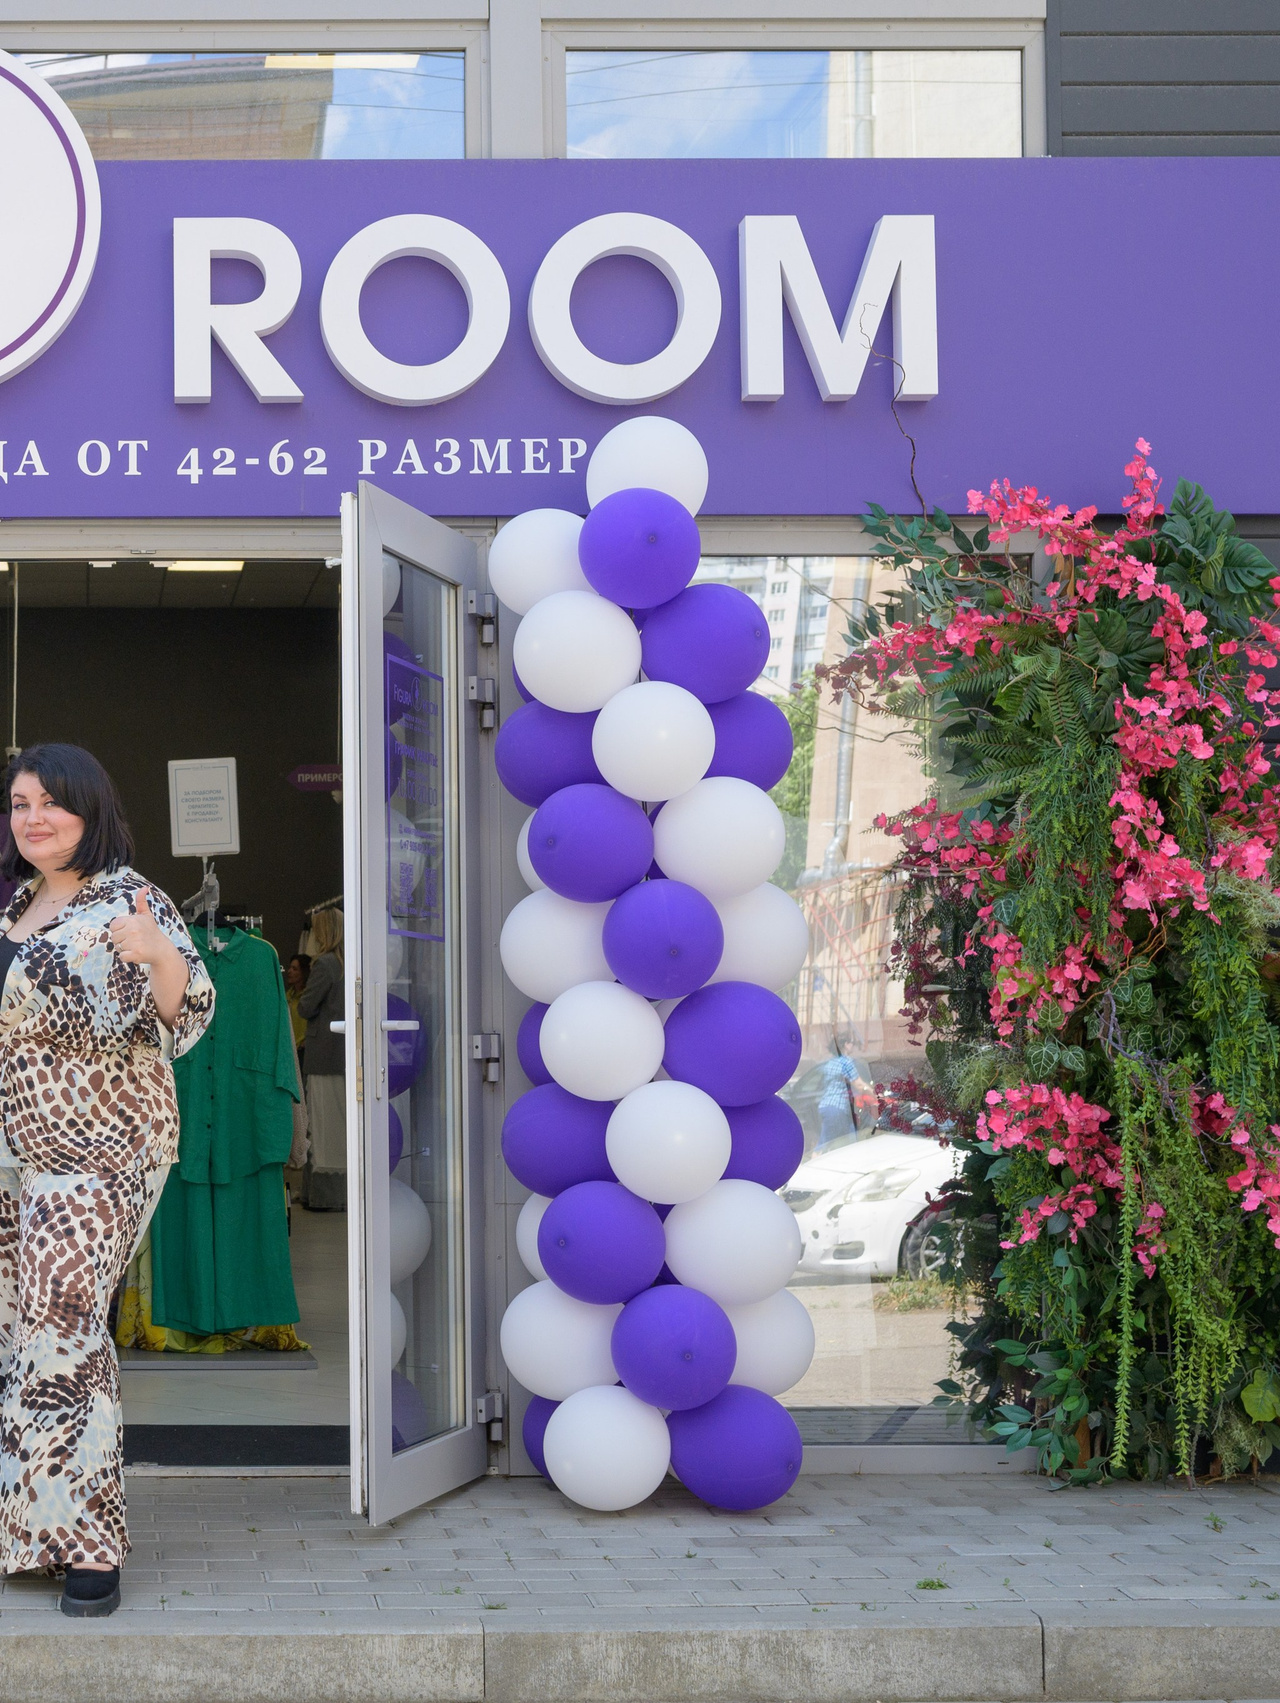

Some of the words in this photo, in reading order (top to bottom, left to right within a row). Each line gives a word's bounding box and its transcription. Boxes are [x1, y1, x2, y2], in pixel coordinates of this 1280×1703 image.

[172, 211, 940, 407] ROOM
[77, 439, 149, 476] ОТ
[176, 438, 328, 485] 42-62
[357, 437, 588, 475] РАЗМЕР
